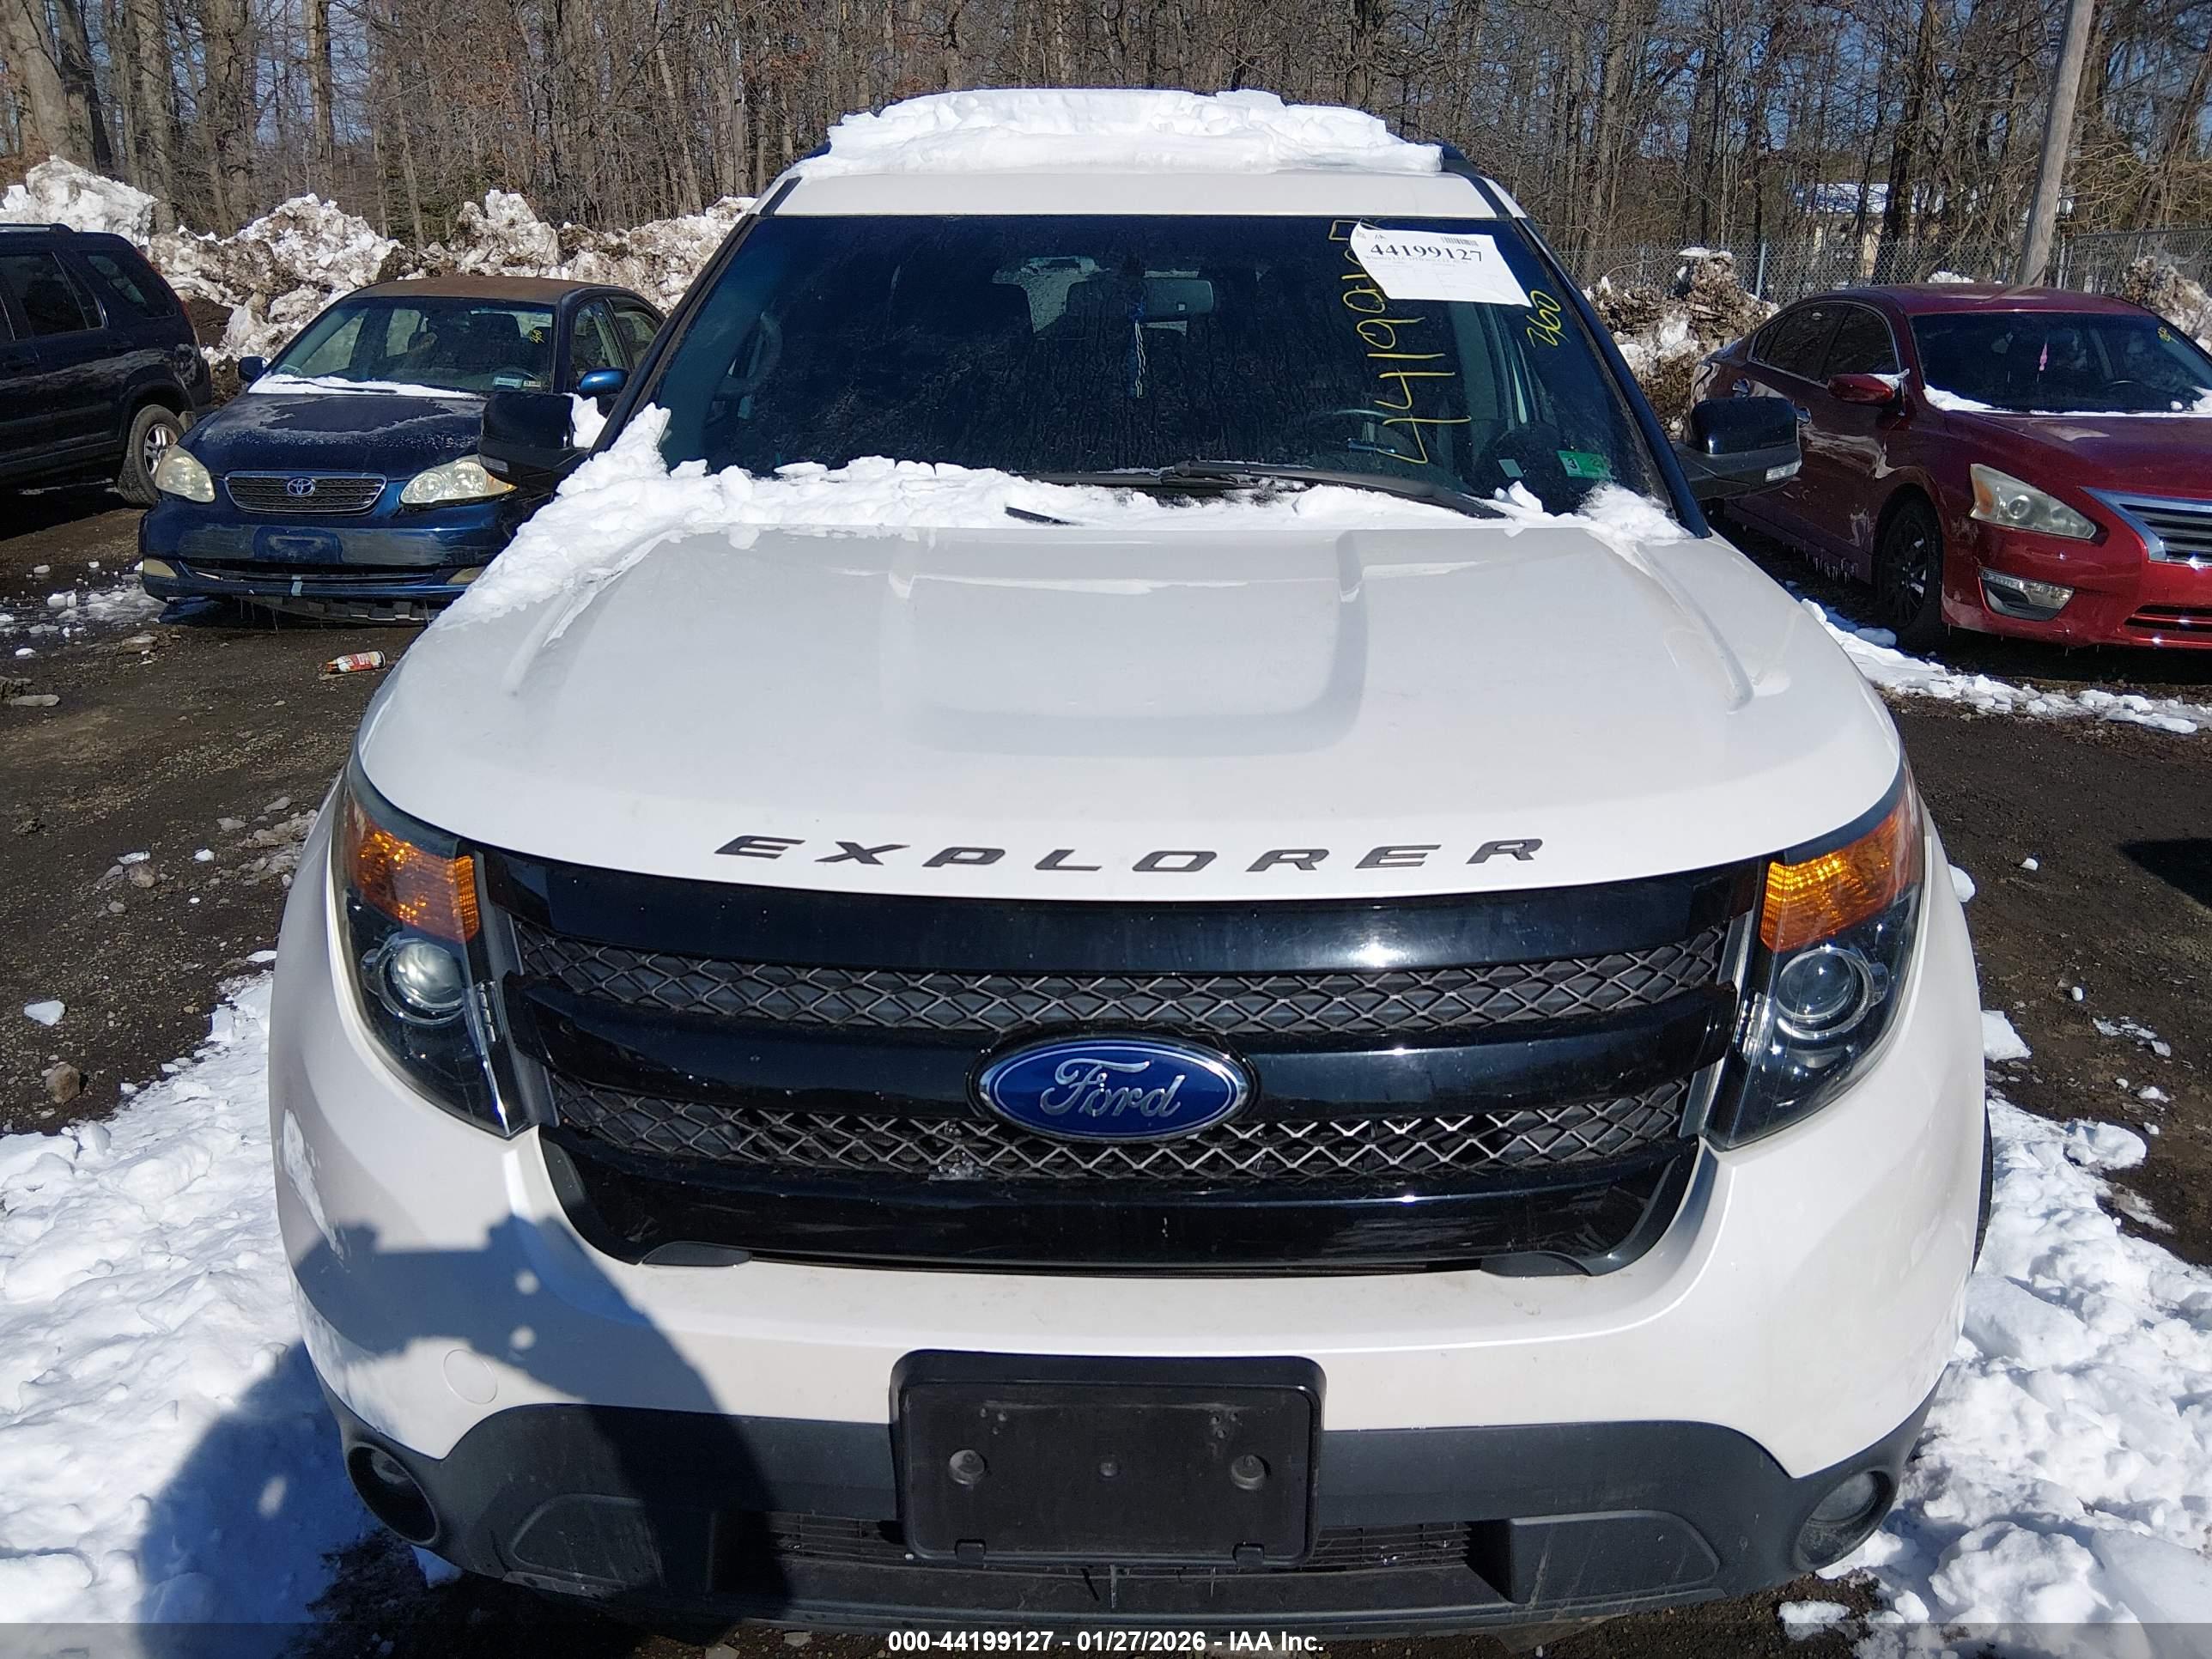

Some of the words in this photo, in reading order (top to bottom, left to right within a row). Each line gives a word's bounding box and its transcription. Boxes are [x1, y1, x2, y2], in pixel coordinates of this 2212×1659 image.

[1370, 243, 1483, 262] 44199127
[714, 835, 1543, 872] EXPLORER
[1040, 1057, 1186, 1117] Ford
